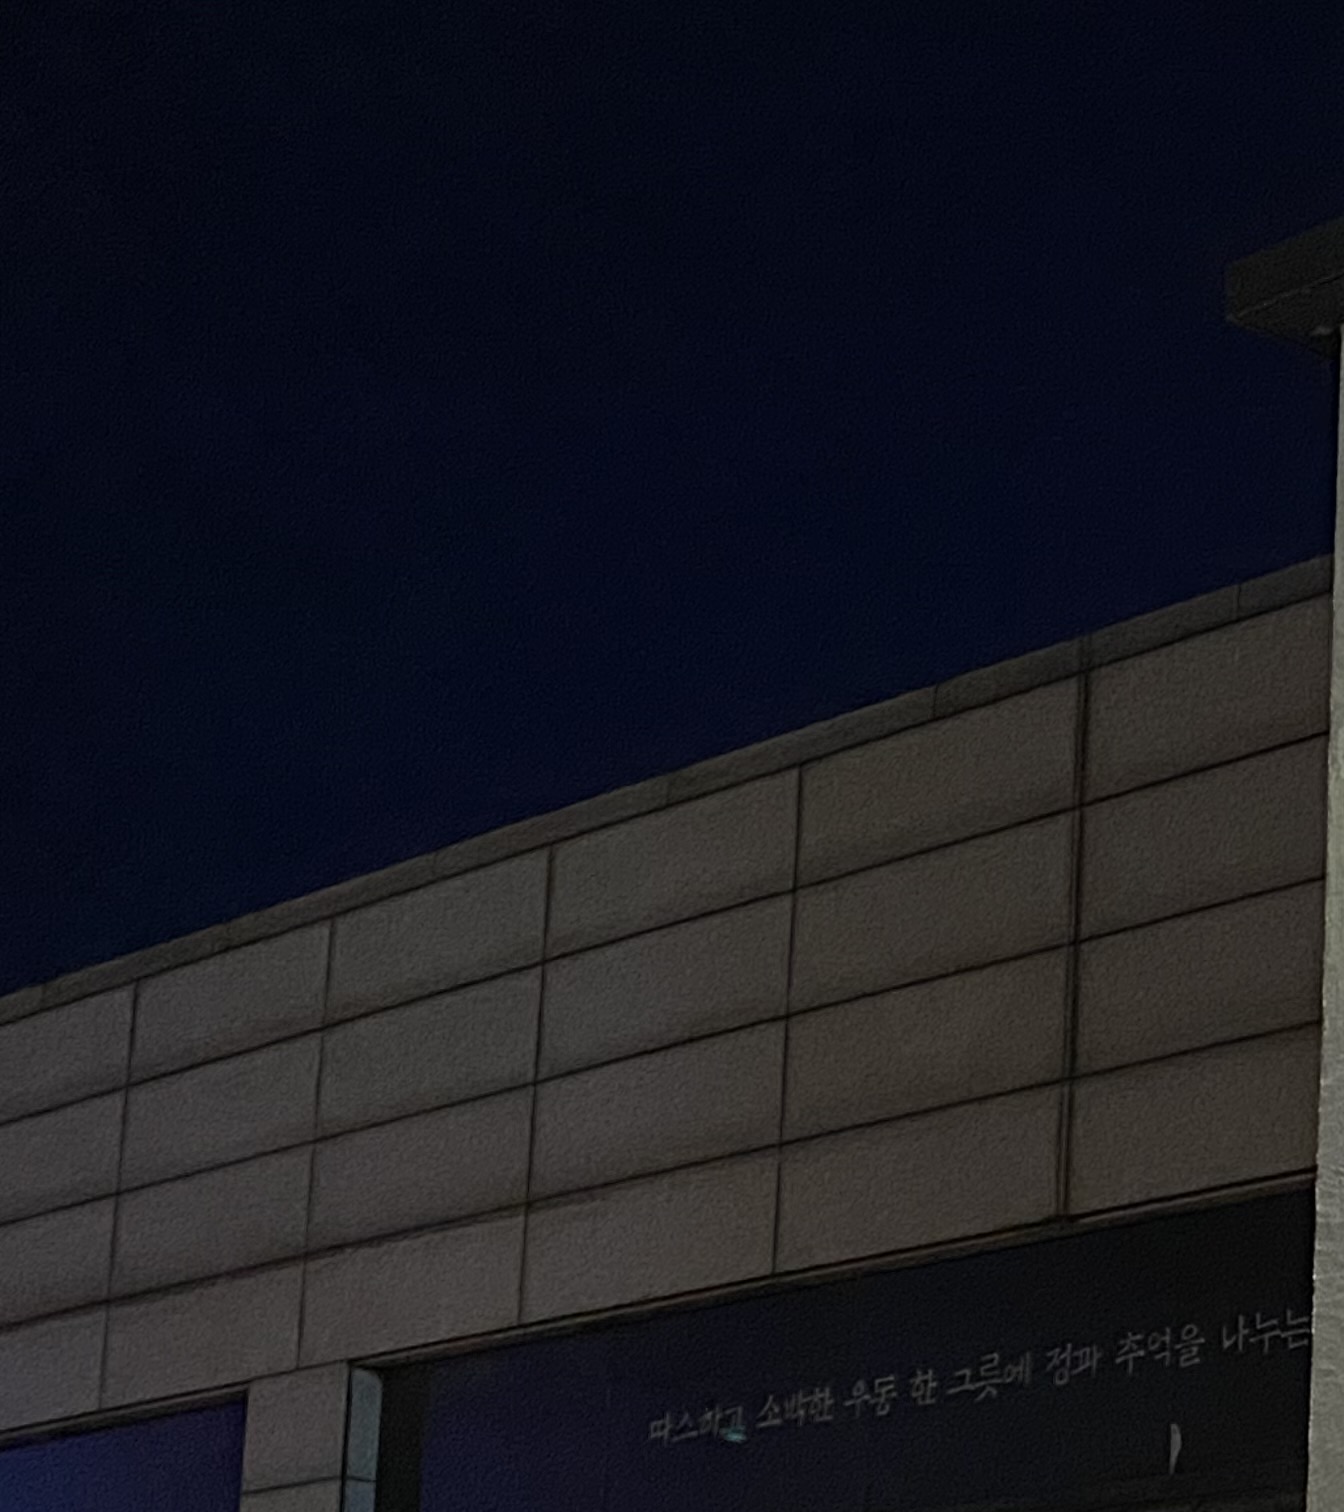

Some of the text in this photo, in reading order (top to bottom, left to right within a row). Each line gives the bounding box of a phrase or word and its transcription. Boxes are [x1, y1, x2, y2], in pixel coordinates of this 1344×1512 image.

[756, 1387, 834, 1426] 소박한
[843, 1375, 897, 1417] 우동
[910, 1368, 937, 1405] 한
[947, 1351, 1032, 1402] 그릇에
[1047, 1343, 1101, 1385] 정과
[1115, 1323, 1205, 1375] 추억을
[1222, 1308, 1311, 1354] 나누는
